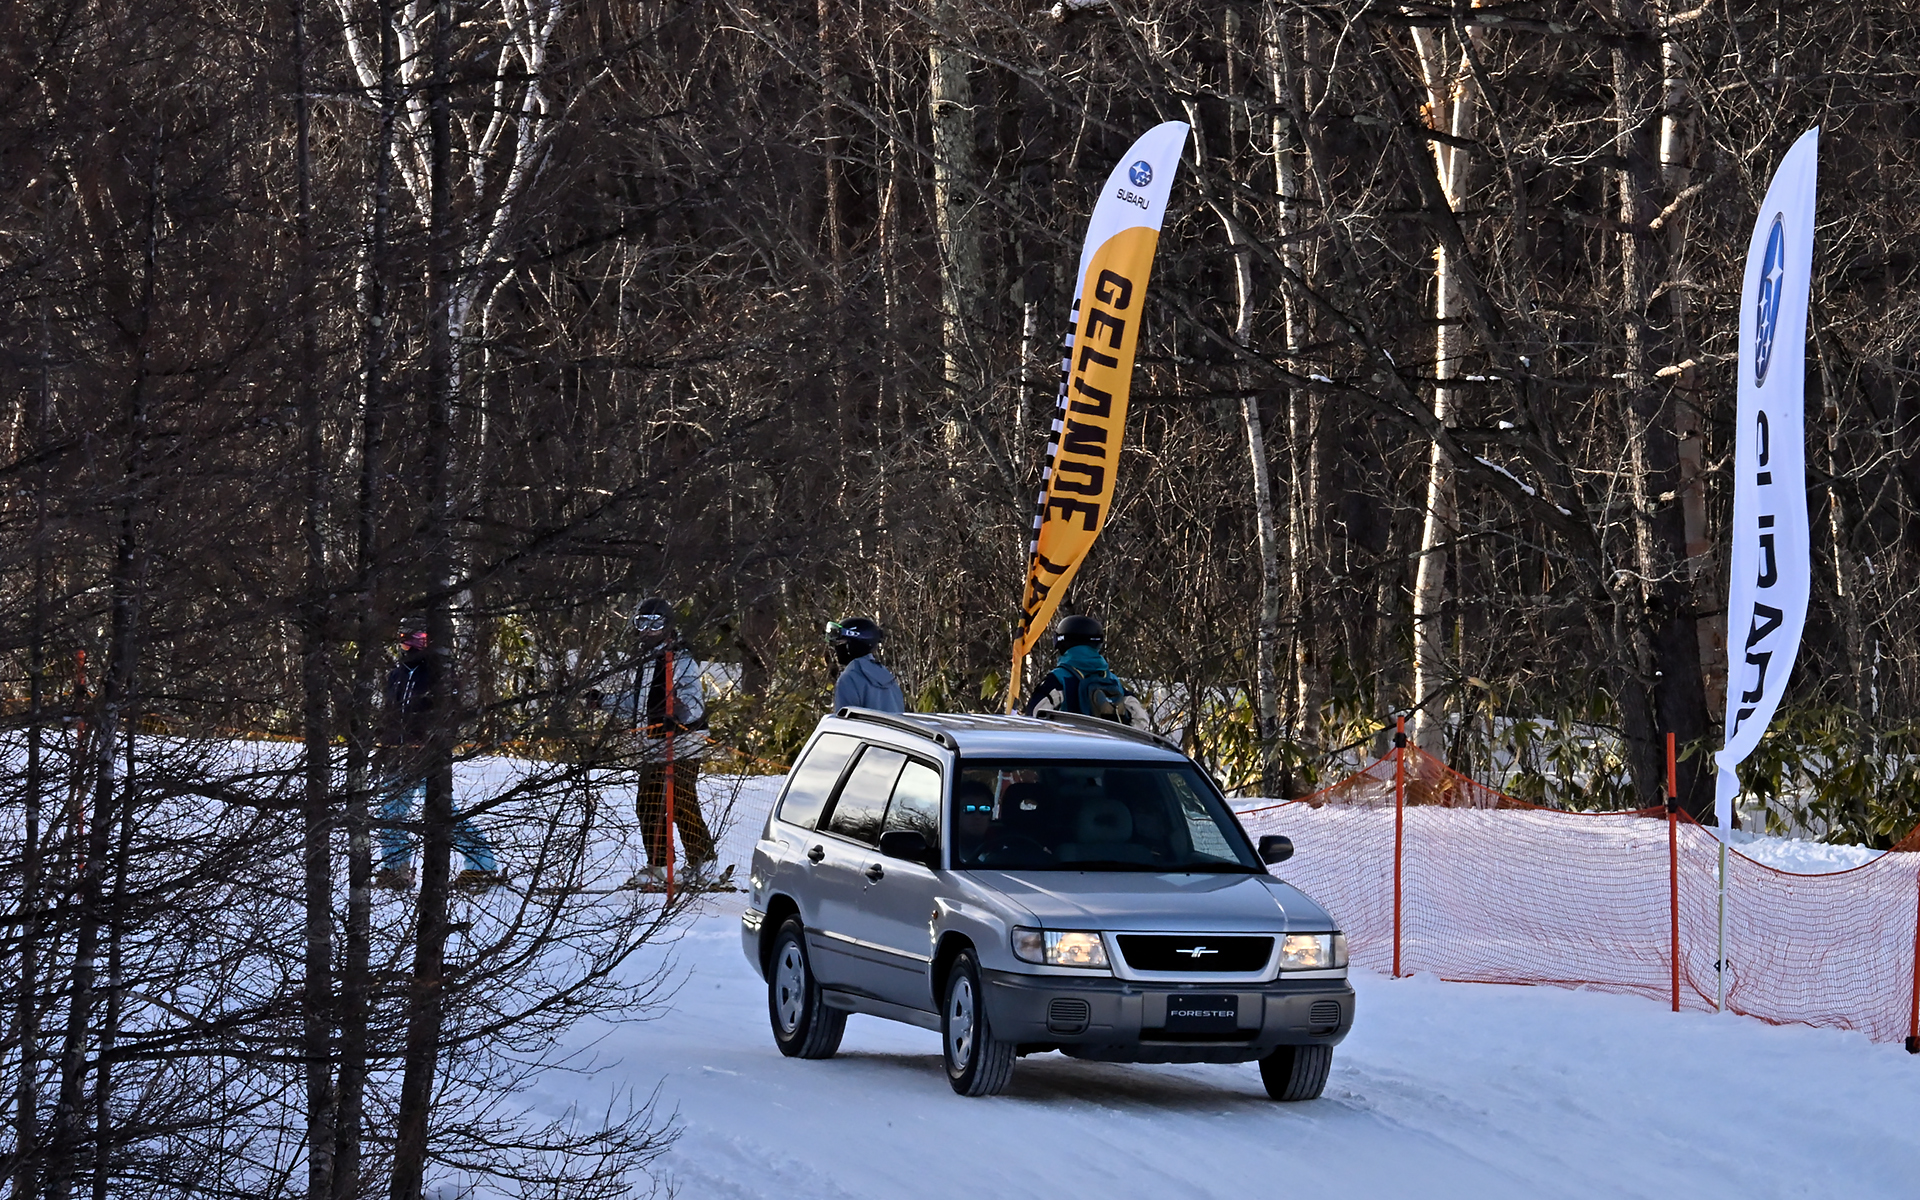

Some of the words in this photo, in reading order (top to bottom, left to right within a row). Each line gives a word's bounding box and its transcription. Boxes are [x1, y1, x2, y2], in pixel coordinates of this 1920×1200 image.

[1116, 188, 1150, 210] SUBARU
[1043, 268, 1133, 532] GELANDE
[1170, 1010, 1235, 1018] FORESTER
